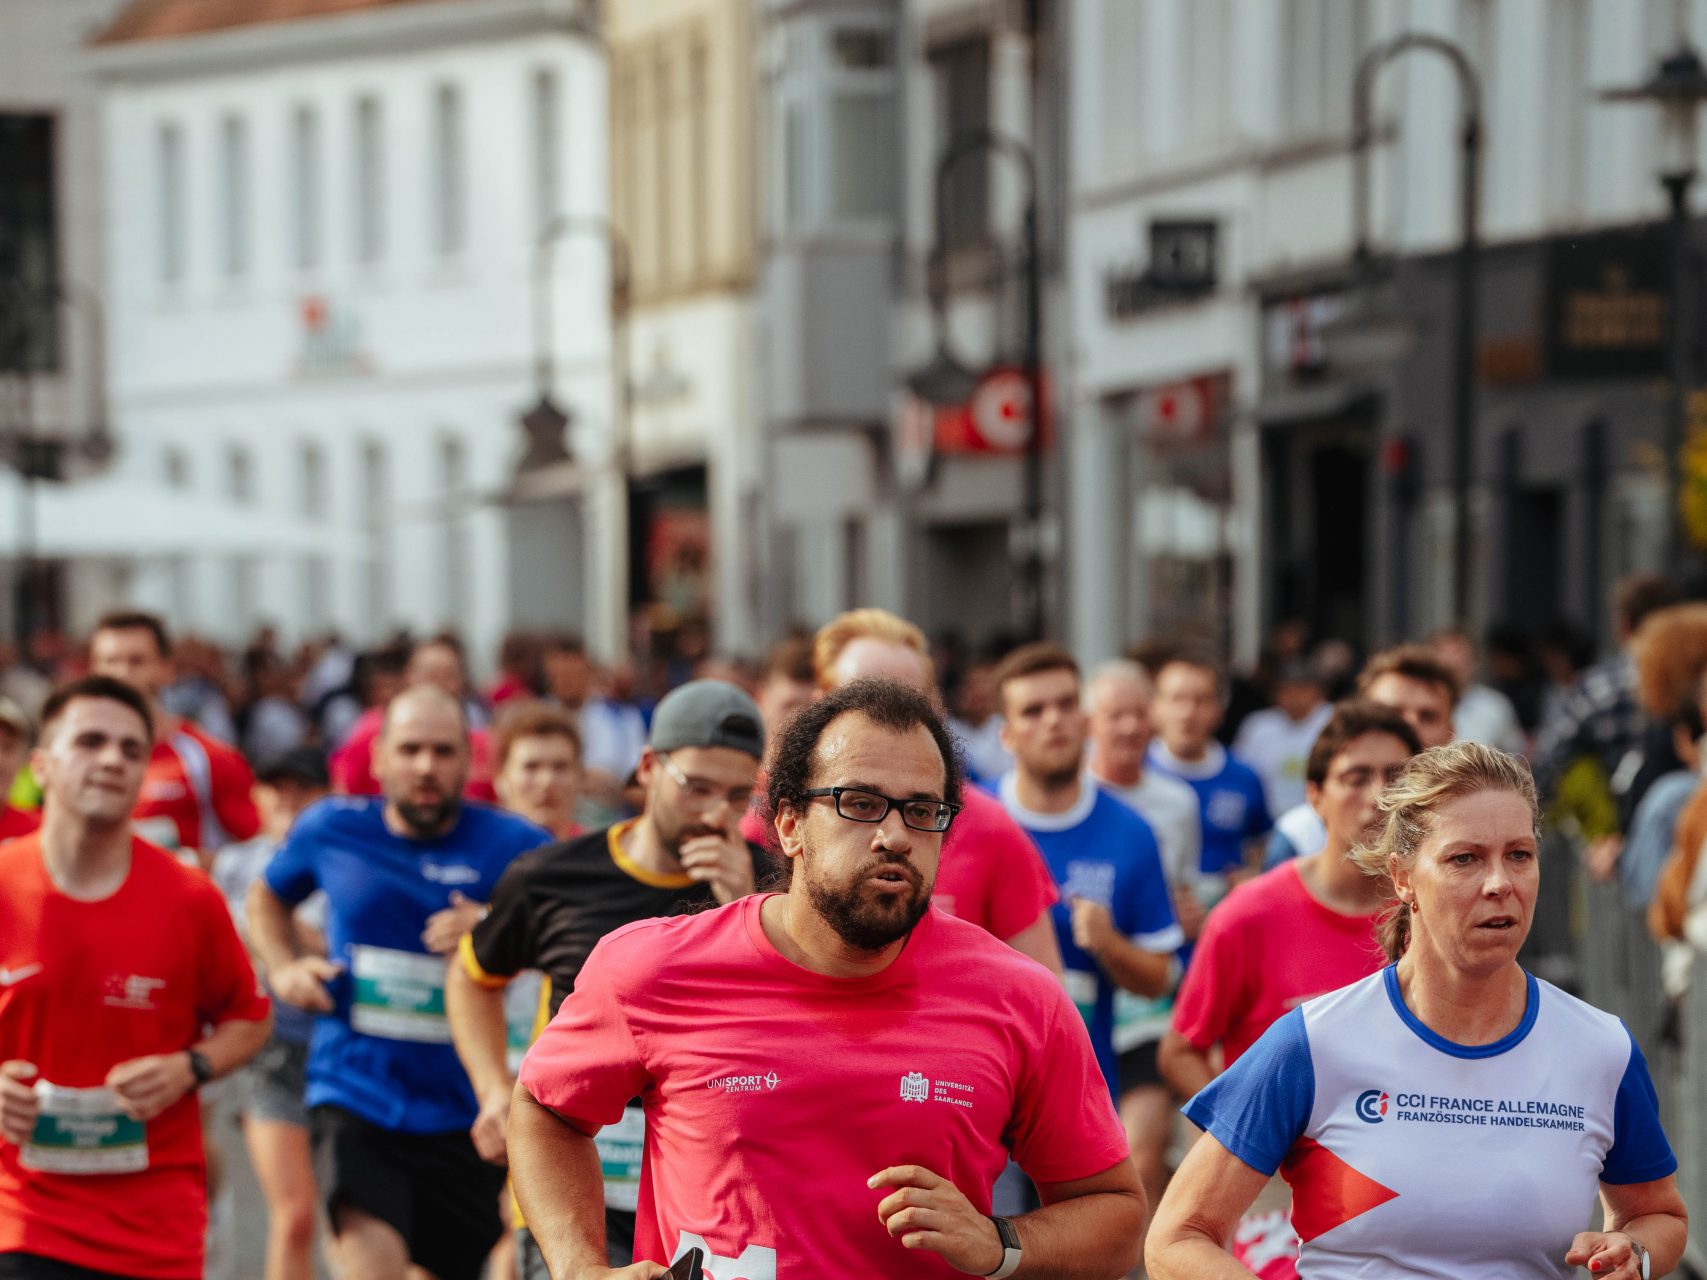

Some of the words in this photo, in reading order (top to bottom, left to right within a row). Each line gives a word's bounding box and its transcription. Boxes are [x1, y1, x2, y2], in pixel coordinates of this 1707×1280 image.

[705, 1075, 761, 1089] UNISPORT
[725, 1085, 761, 1093] ZENTRUM
[935, 1079, 974, 1092] UNIVERSITÄT
[934, 1087, 947, 1095] DES
[934, 1094, 974, 1108] SAARLANDES
[1396, 1093, 1426, 1108] CCI
[1430, 1096, 1494, 1112] FRANCE
[1497, 1100, 1585, 1119] ALLEMAGNE
[1397, 1110, 1487, 1126] FRANZÖSISCHE
[1490, 1116, 1585, 1132] HANDELSKAMMER
